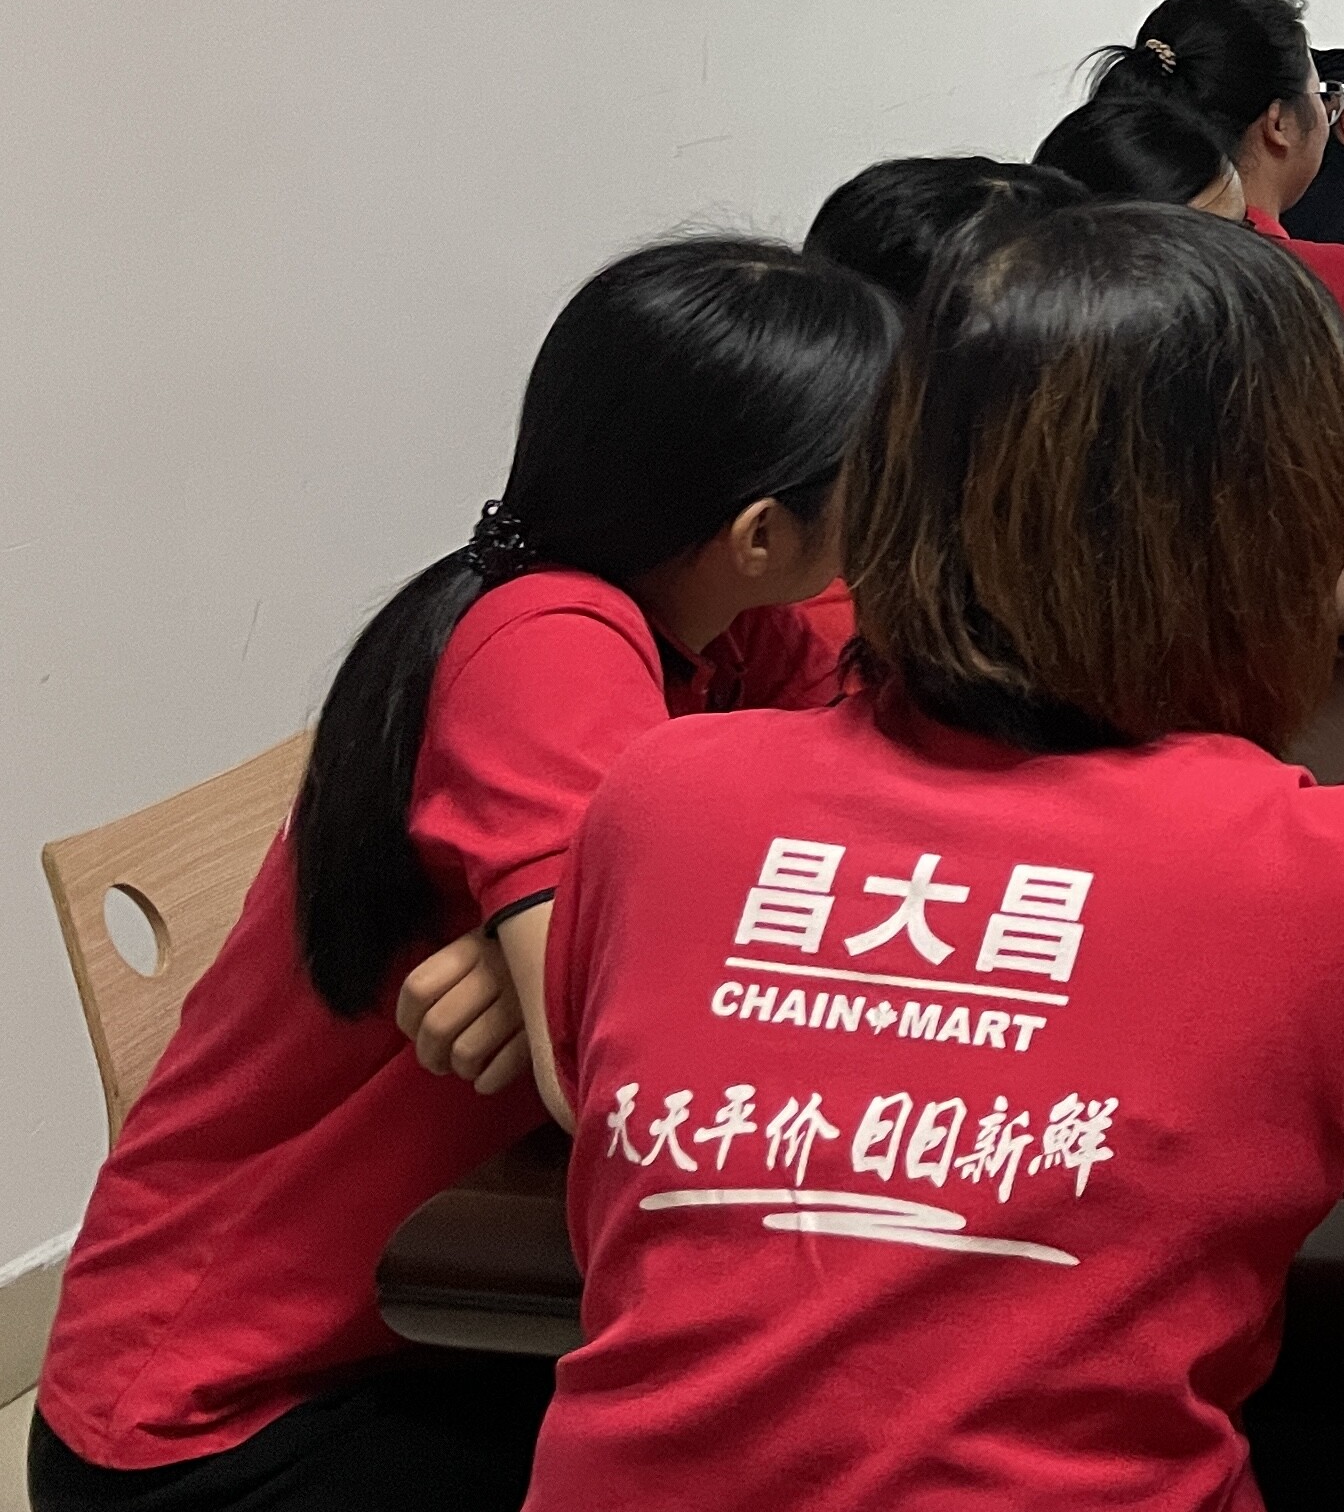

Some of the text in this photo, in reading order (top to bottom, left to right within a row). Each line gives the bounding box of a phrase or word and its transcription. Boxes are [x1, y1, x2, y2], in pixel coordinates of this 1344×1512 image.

[734, 836, 1095, 983] 昌大昌
[711, 981, 1047, 1052] CHAIN MART
[606, 1082, 841, 1188] 天天平价
